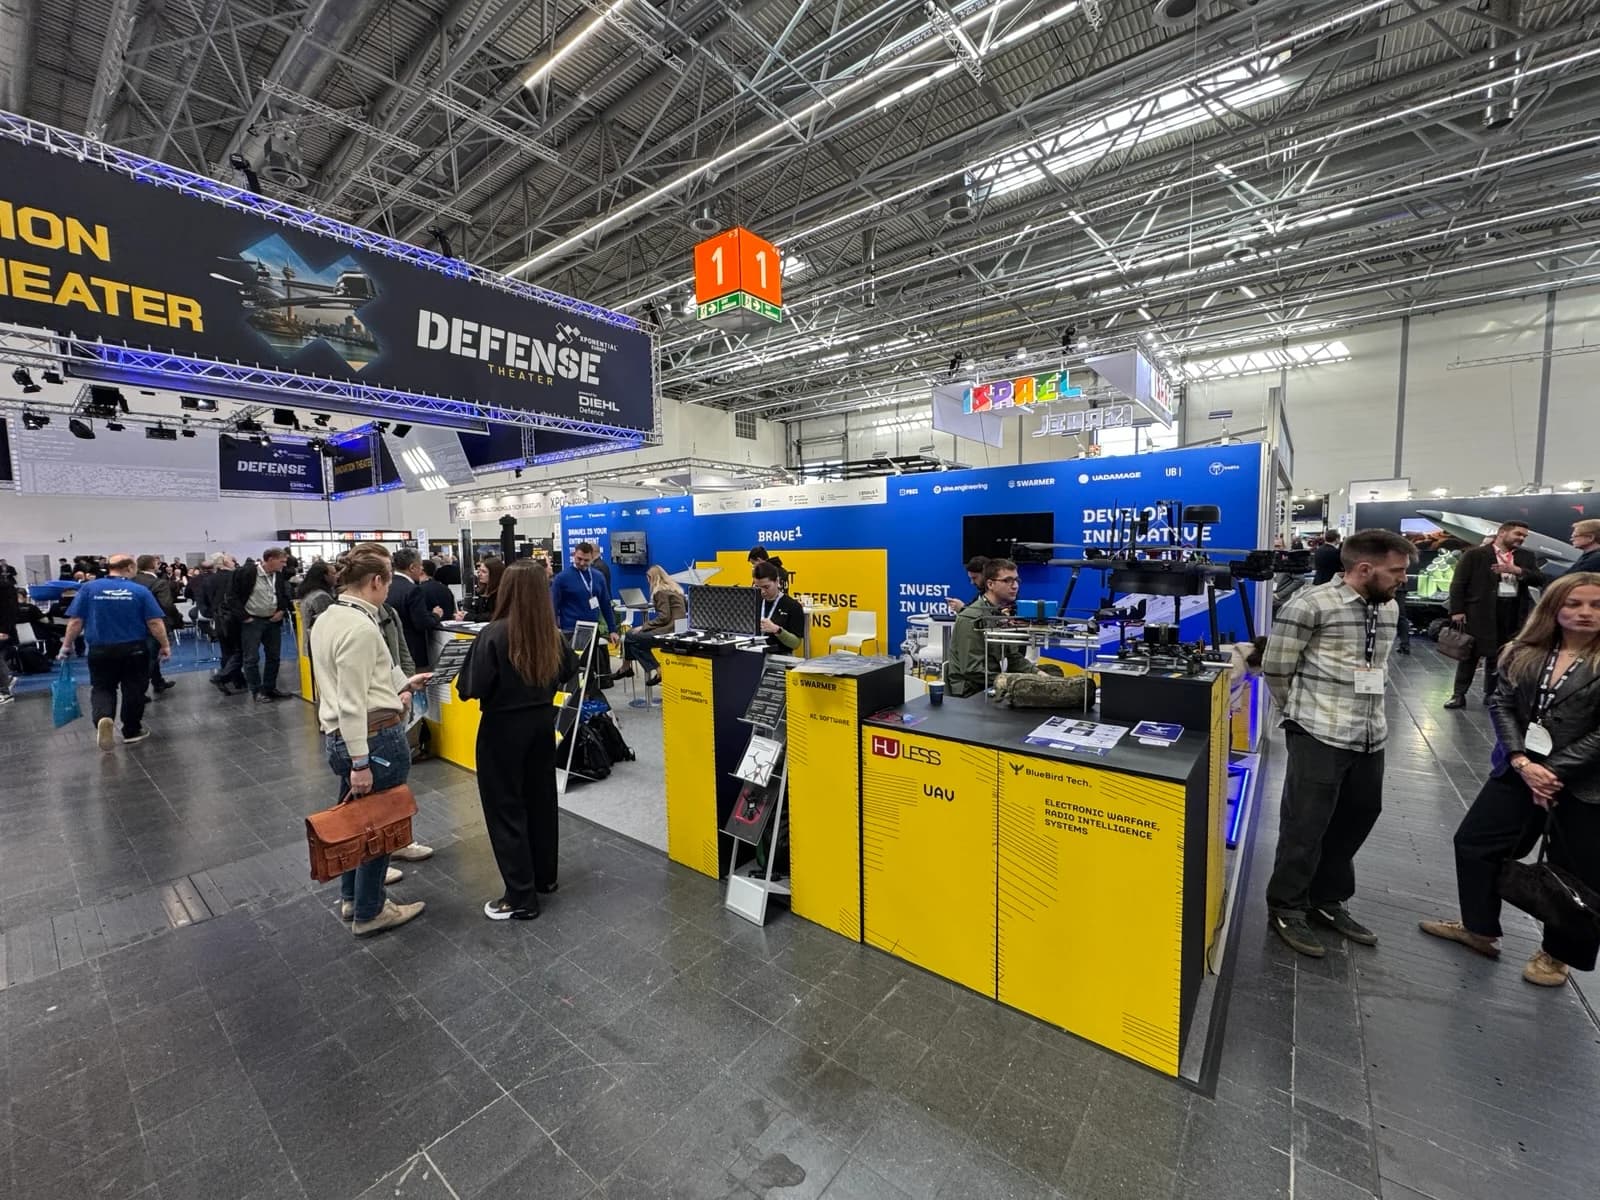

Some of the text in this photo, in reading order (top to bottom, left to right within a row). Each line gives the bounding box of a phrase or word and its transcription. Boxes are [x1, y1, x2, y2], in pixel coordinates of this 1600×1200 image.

[711, 246, 724, 286] 1
[755, 250, 767, 289] 1
[416, 308, 601, 386] DEFENSE
[487, 363, 554, 386] THEATER
[579, 395, 621, 412] DIEHL
[579, 406, 605, 417] Defence
[237, 460, 307, 476] DEFENSE
[1092, 471, 1142, 482] UADAMAGE
[1016, 478, 1056, 488] SWARMER
[1082, 505, 1169, 524] DEVELOP
[899, 583, 951, 597] INVEST
[899, 600, 916, 613] IN
[800, 679, 837, 691] SWARMER
[819, 714, 850, 726] SOFTWARE
[1025, 768, 1064, 783] BlueBird
[923, 783, 955, 802] UAV
[1044, 798, 1161, 832] ELECTRONIC WARFARE,
[1044, 809, 1153, 840] RADIO INTELLIGENCE
[1044, 818, 1089, 835] SYSTEMS
